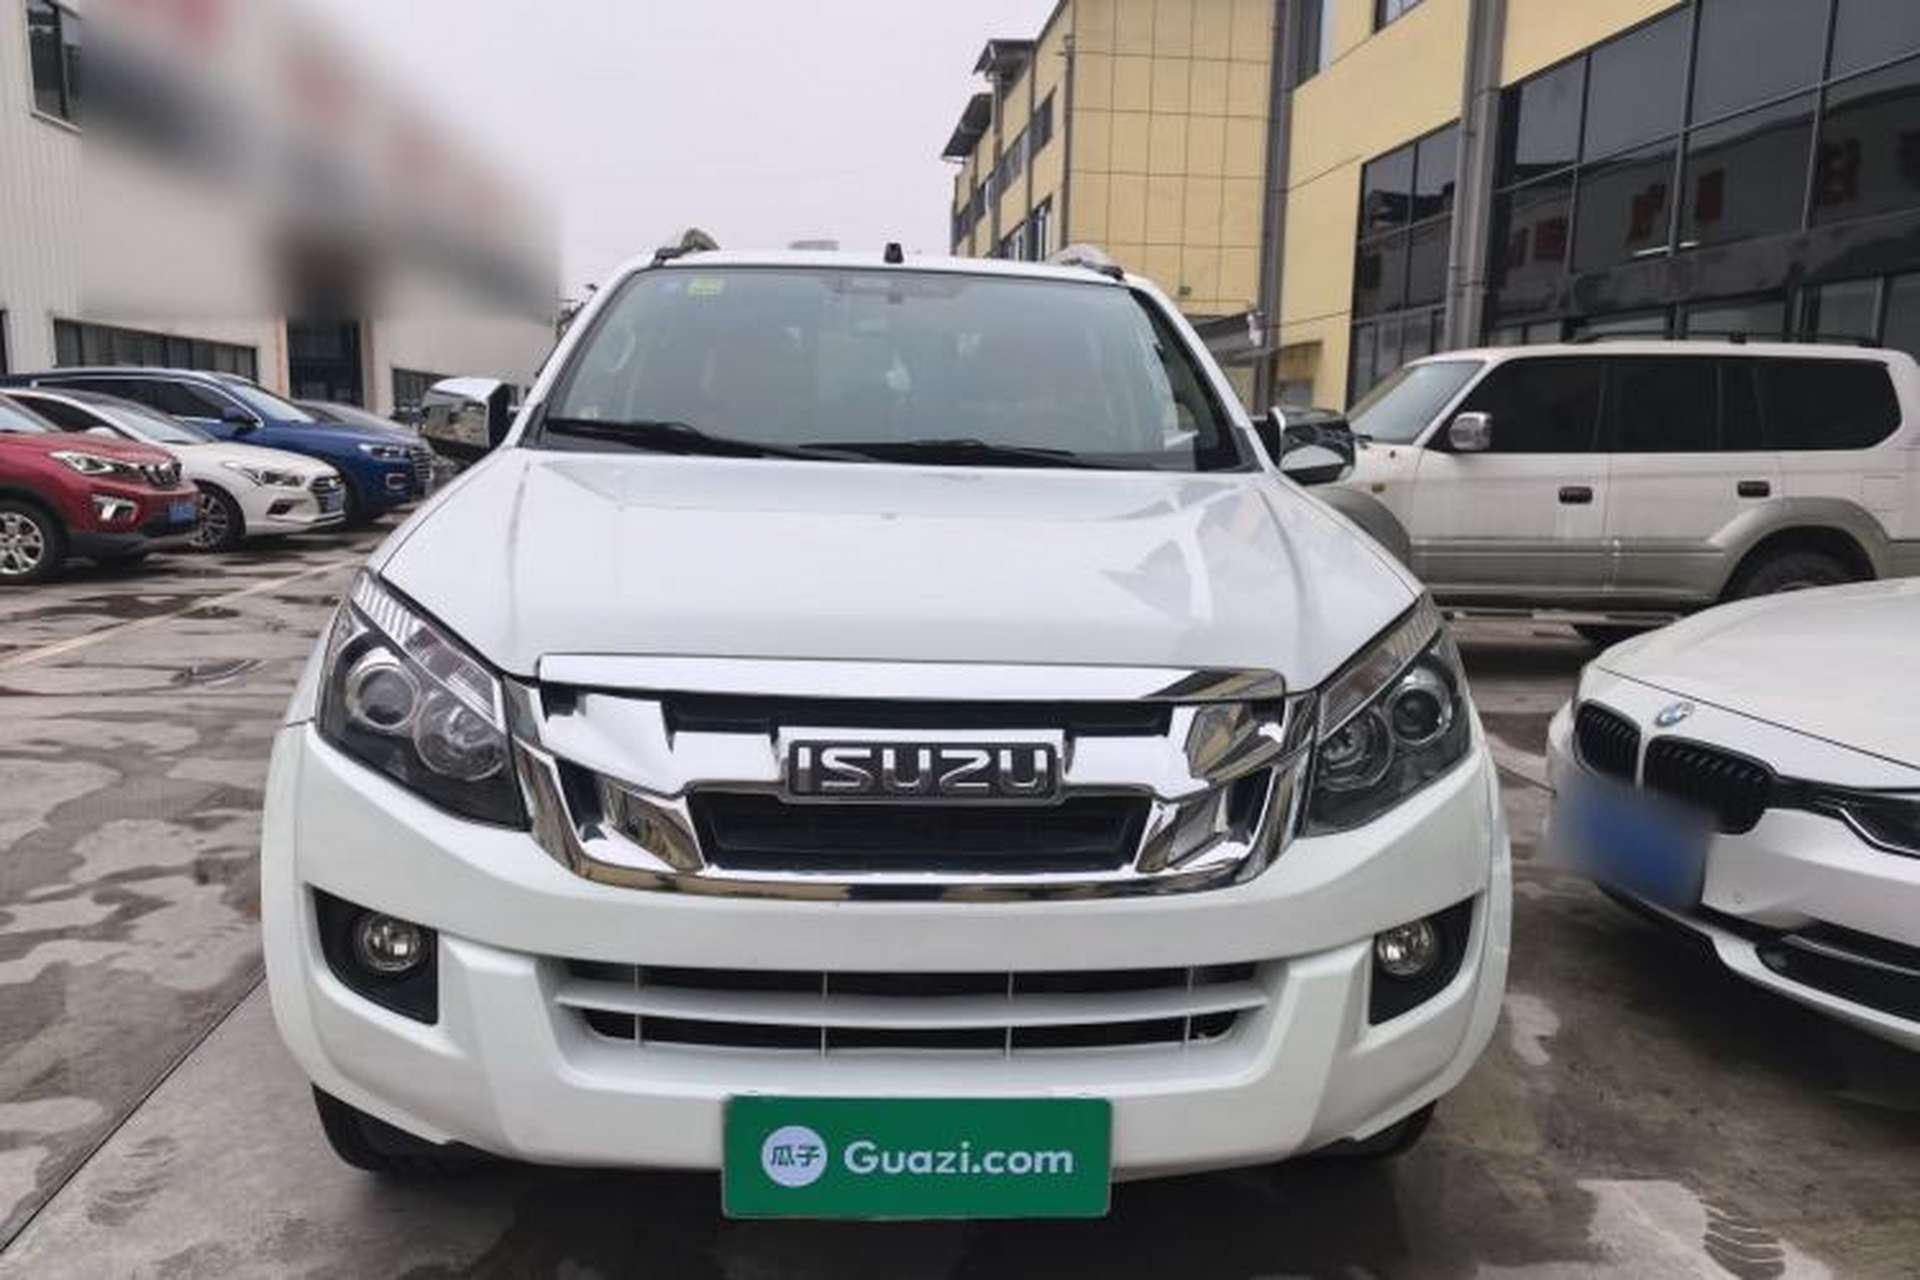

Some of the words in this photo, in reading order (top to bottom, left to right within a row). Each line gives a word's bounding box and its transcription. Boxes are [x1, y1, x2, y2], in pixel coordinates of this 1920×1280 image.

[797, 747, 1048, 793] ISUZU
[770, 1144, 820, 1167] 瓜子
[844, 1140, 1073, 1174] Guazi.com
